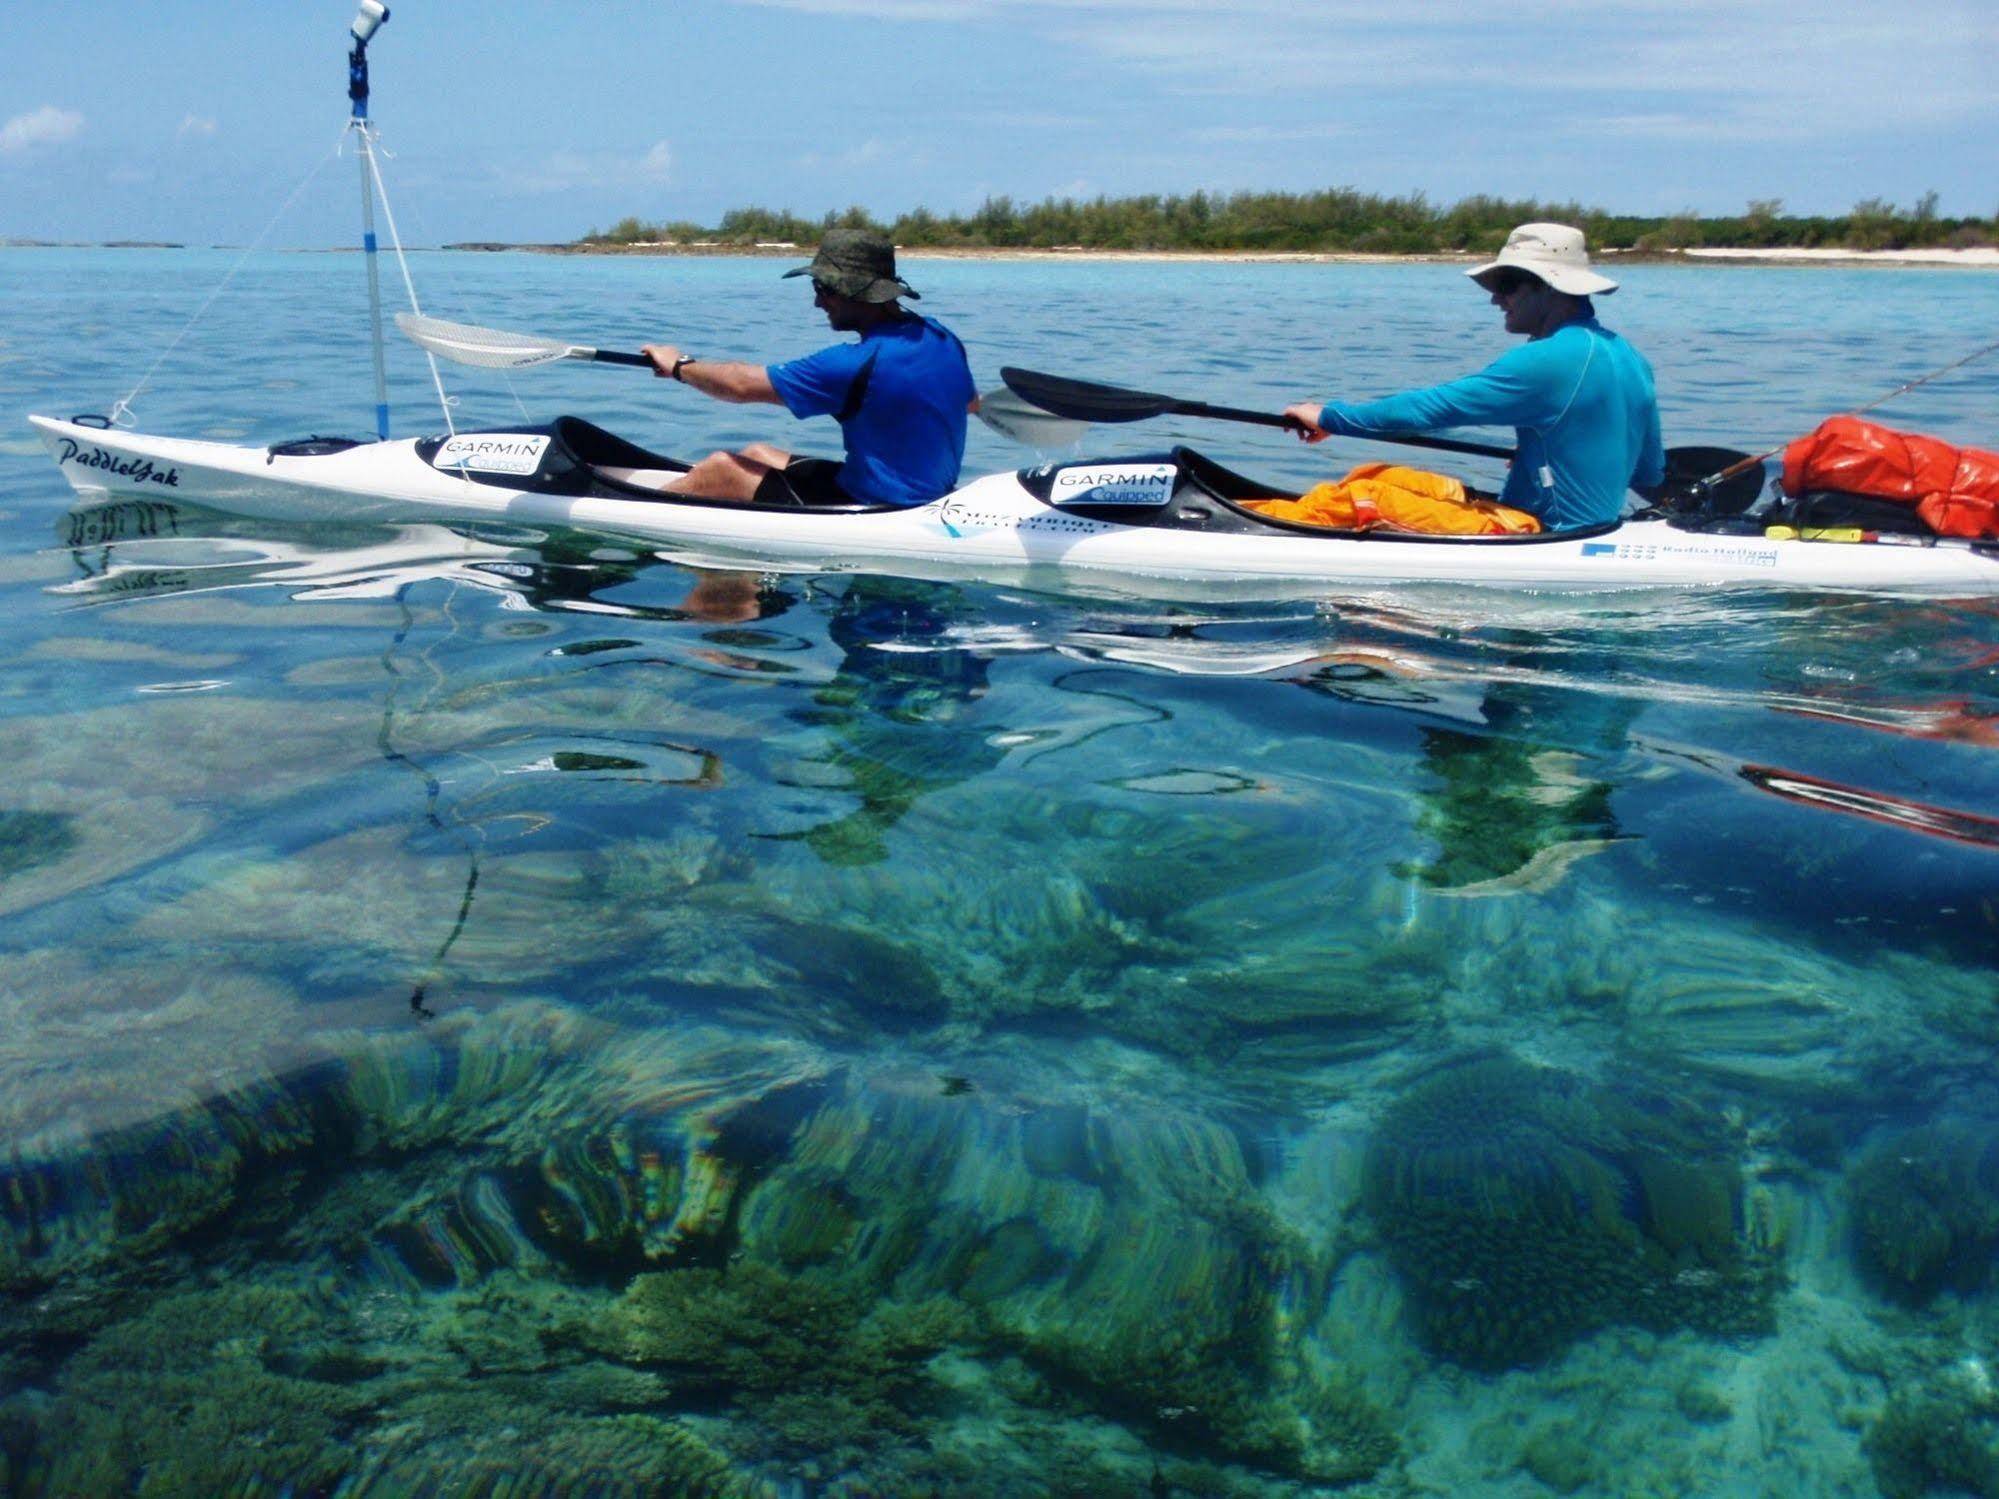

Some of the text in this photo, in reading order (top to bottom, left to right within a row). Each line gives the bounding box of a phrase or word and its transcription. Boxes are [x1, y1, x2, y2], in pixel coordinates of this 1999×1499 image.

[446, 441, 540, 456] GARMIN
[57, 438, 180, 487] PaddleYak
[1059, 473, 1168, 486] GARMIN
